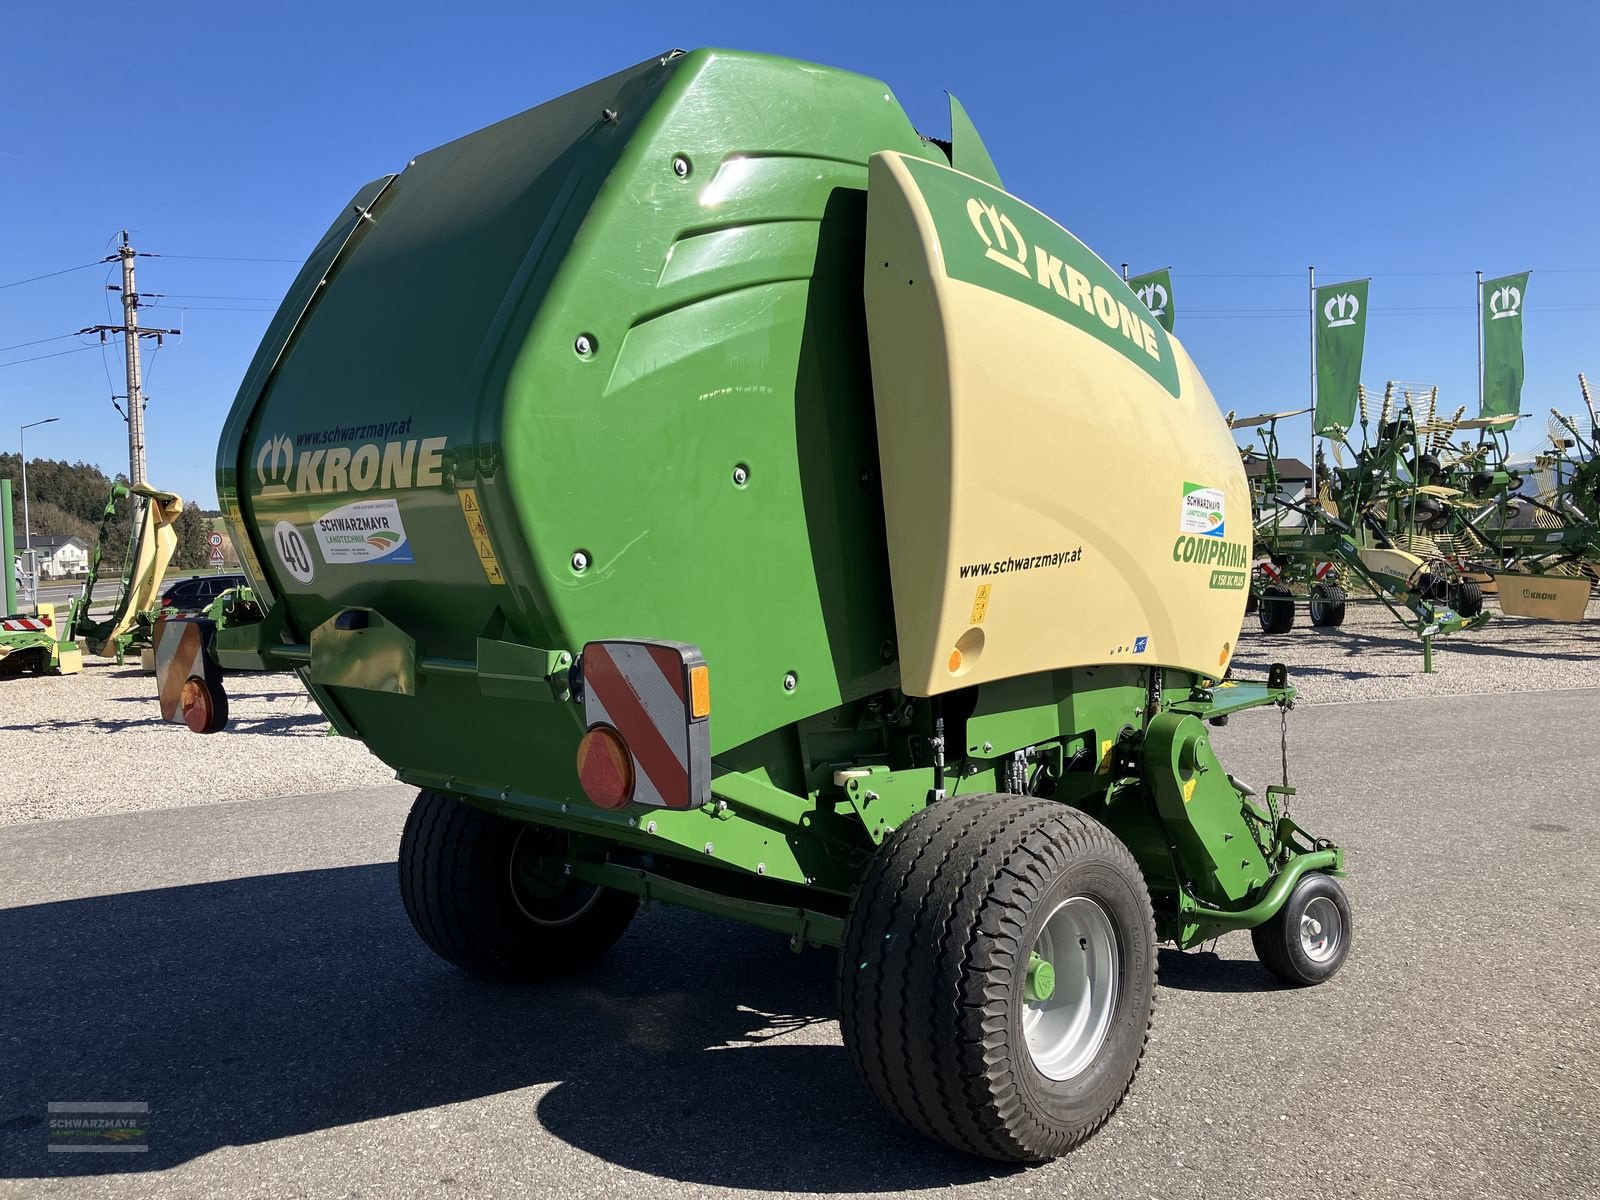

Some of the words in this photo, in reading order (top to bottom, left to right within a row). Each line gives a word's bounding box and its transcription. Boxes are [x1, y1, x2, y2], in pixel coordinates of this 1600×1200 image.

[1034, 244, 1161, 362] KRONE
[296, 415, 412, 447] www.schwarzmayr.at
[296, 436, 448, 495] KRONE
[1187, 495, 1220, 511] SCHWARZMAYR
[319, 516, 390, 532] SCHWARZMAYR
[325, 534, 367, 543] LANDTECHNIK
[278, 531, 310, 574] 40
[960, 545, 1082, 578] www.schwarzmayr.at
[1172, 535, 1247, 568] COMPRIMA
[1234, 575, 1245, 587] PLUS
[1530, 592, 1557, 600] KRONE
